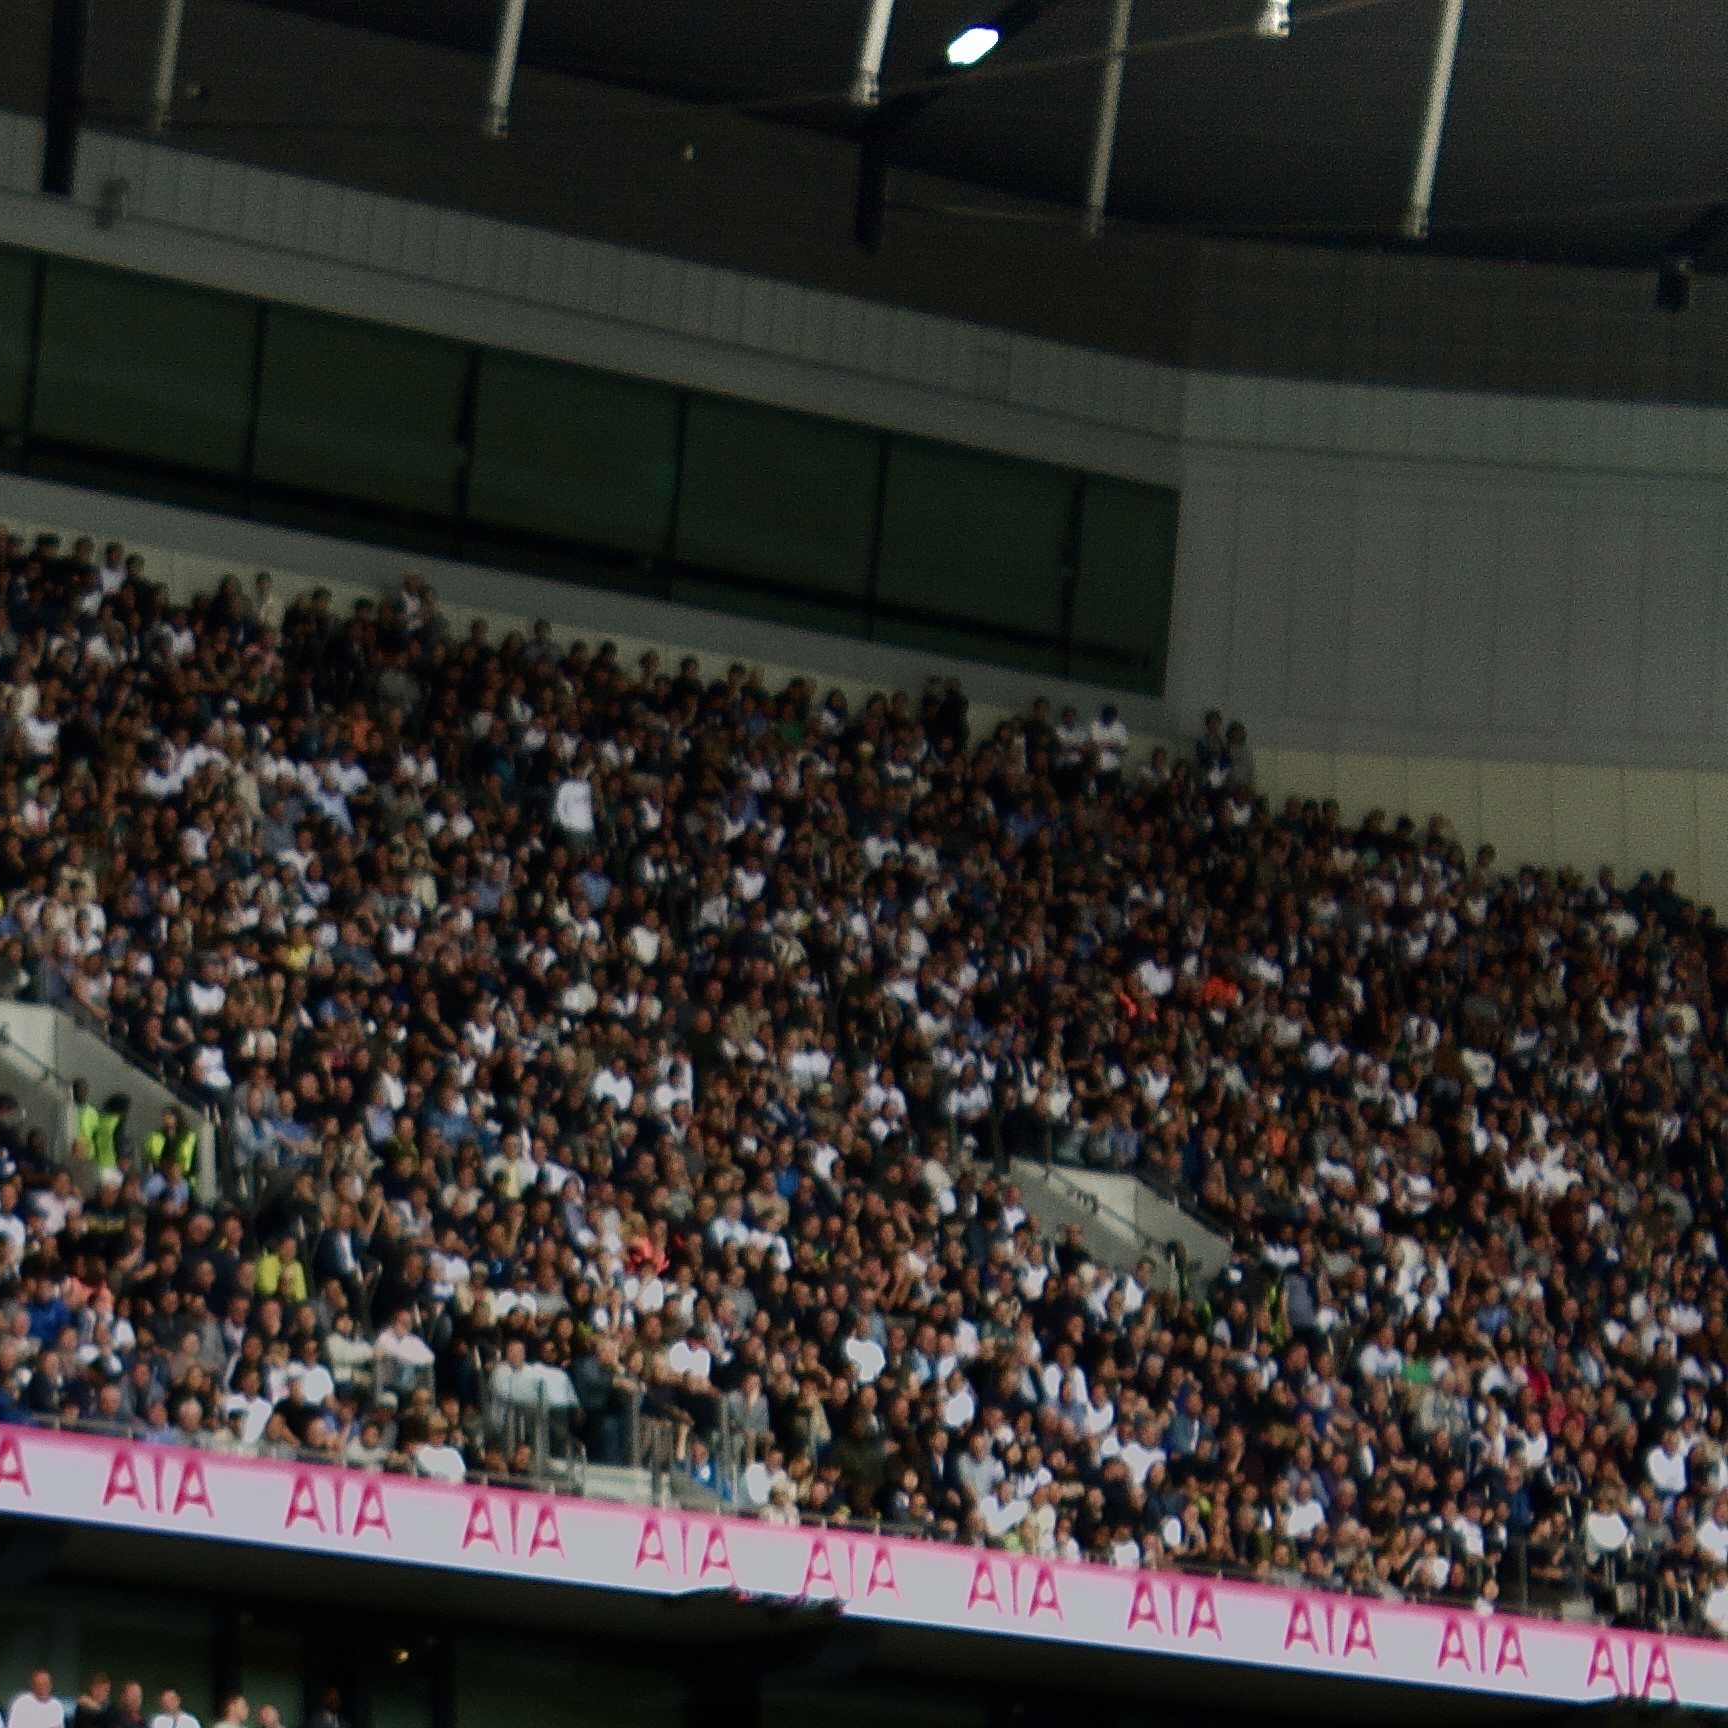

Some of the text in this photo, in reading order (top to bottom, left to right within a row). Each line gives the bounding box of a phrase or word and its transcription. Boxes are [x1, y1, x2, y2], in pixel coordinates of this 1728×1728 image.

[103, 1447, 216, 1520] AIA
[285, 1473, 392, 1541] AIA
[462, 1496, 566, 1559] AIA
[635, 1518, 736, 1583] AIA
[800, 1541, 901, 1601] AIA
[967, 1559, 1064, 1621] AIA
[1126, 1580, 1222, 1642] AIA
[1284, 1601, 1376, 1661] AIA
[1437, 1619, 1529, 1679] AIA
[1587, 1636, 1677, 1702] AIA
